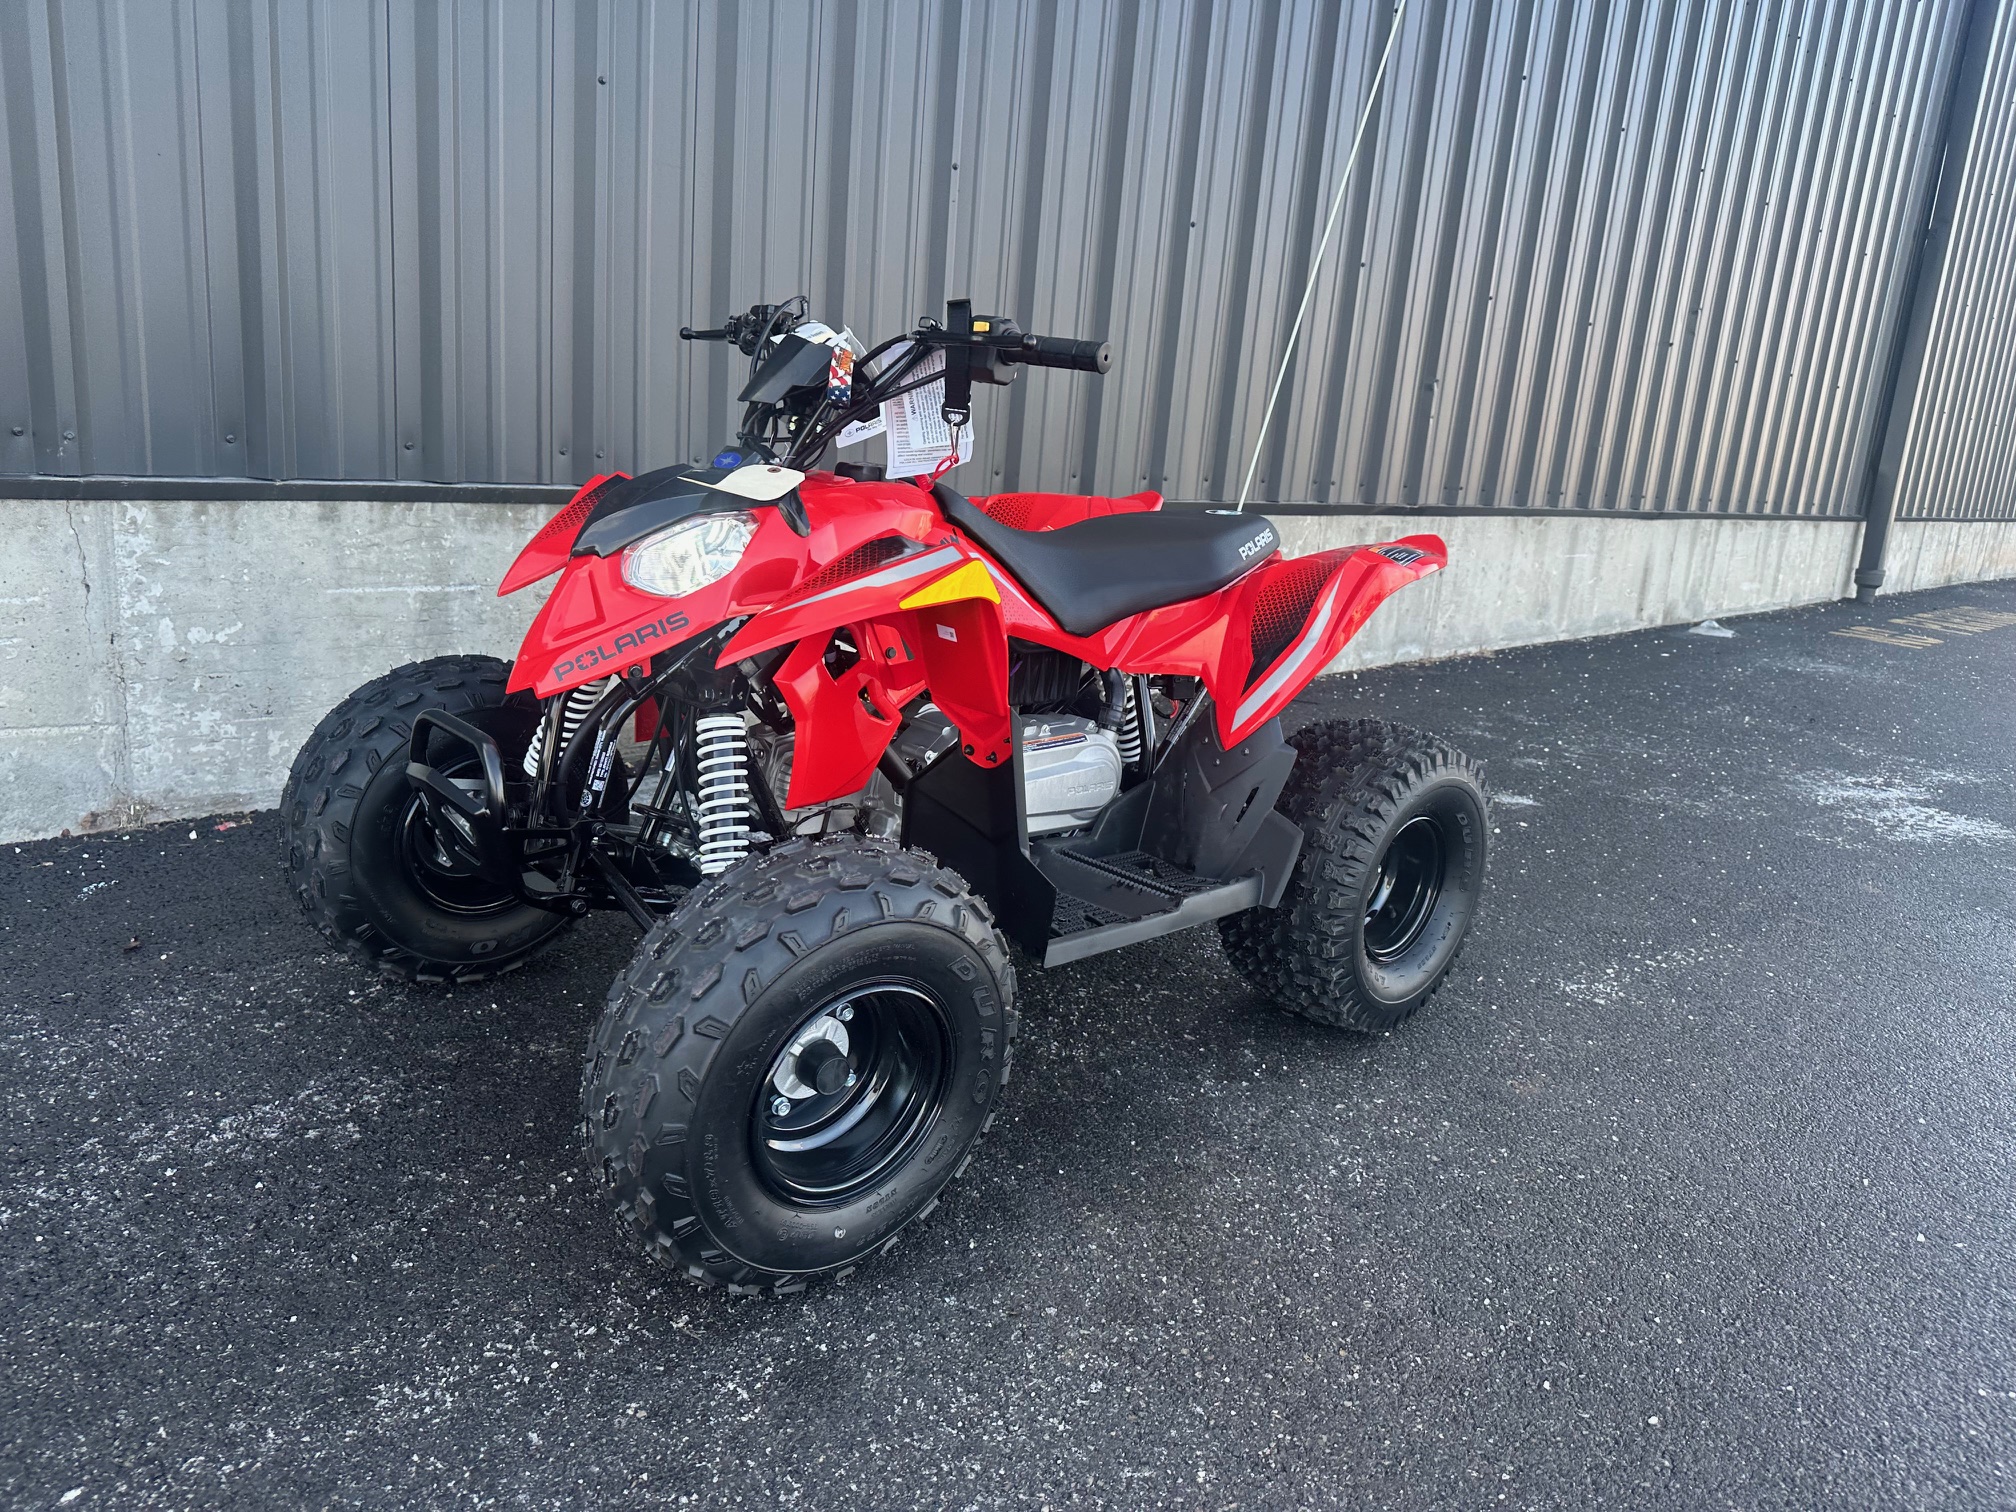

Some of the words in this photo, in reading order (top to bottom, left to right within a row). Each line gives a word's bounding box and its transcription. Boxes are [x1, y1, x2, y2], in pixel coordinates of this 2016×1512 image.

[1238, 527, 1274, 561] POLARIS
[553, 610, 690, 683] POLARIS
[1067, 780, 1114, 797] POLARIS
[947, 955, 997, 1104] DURO
